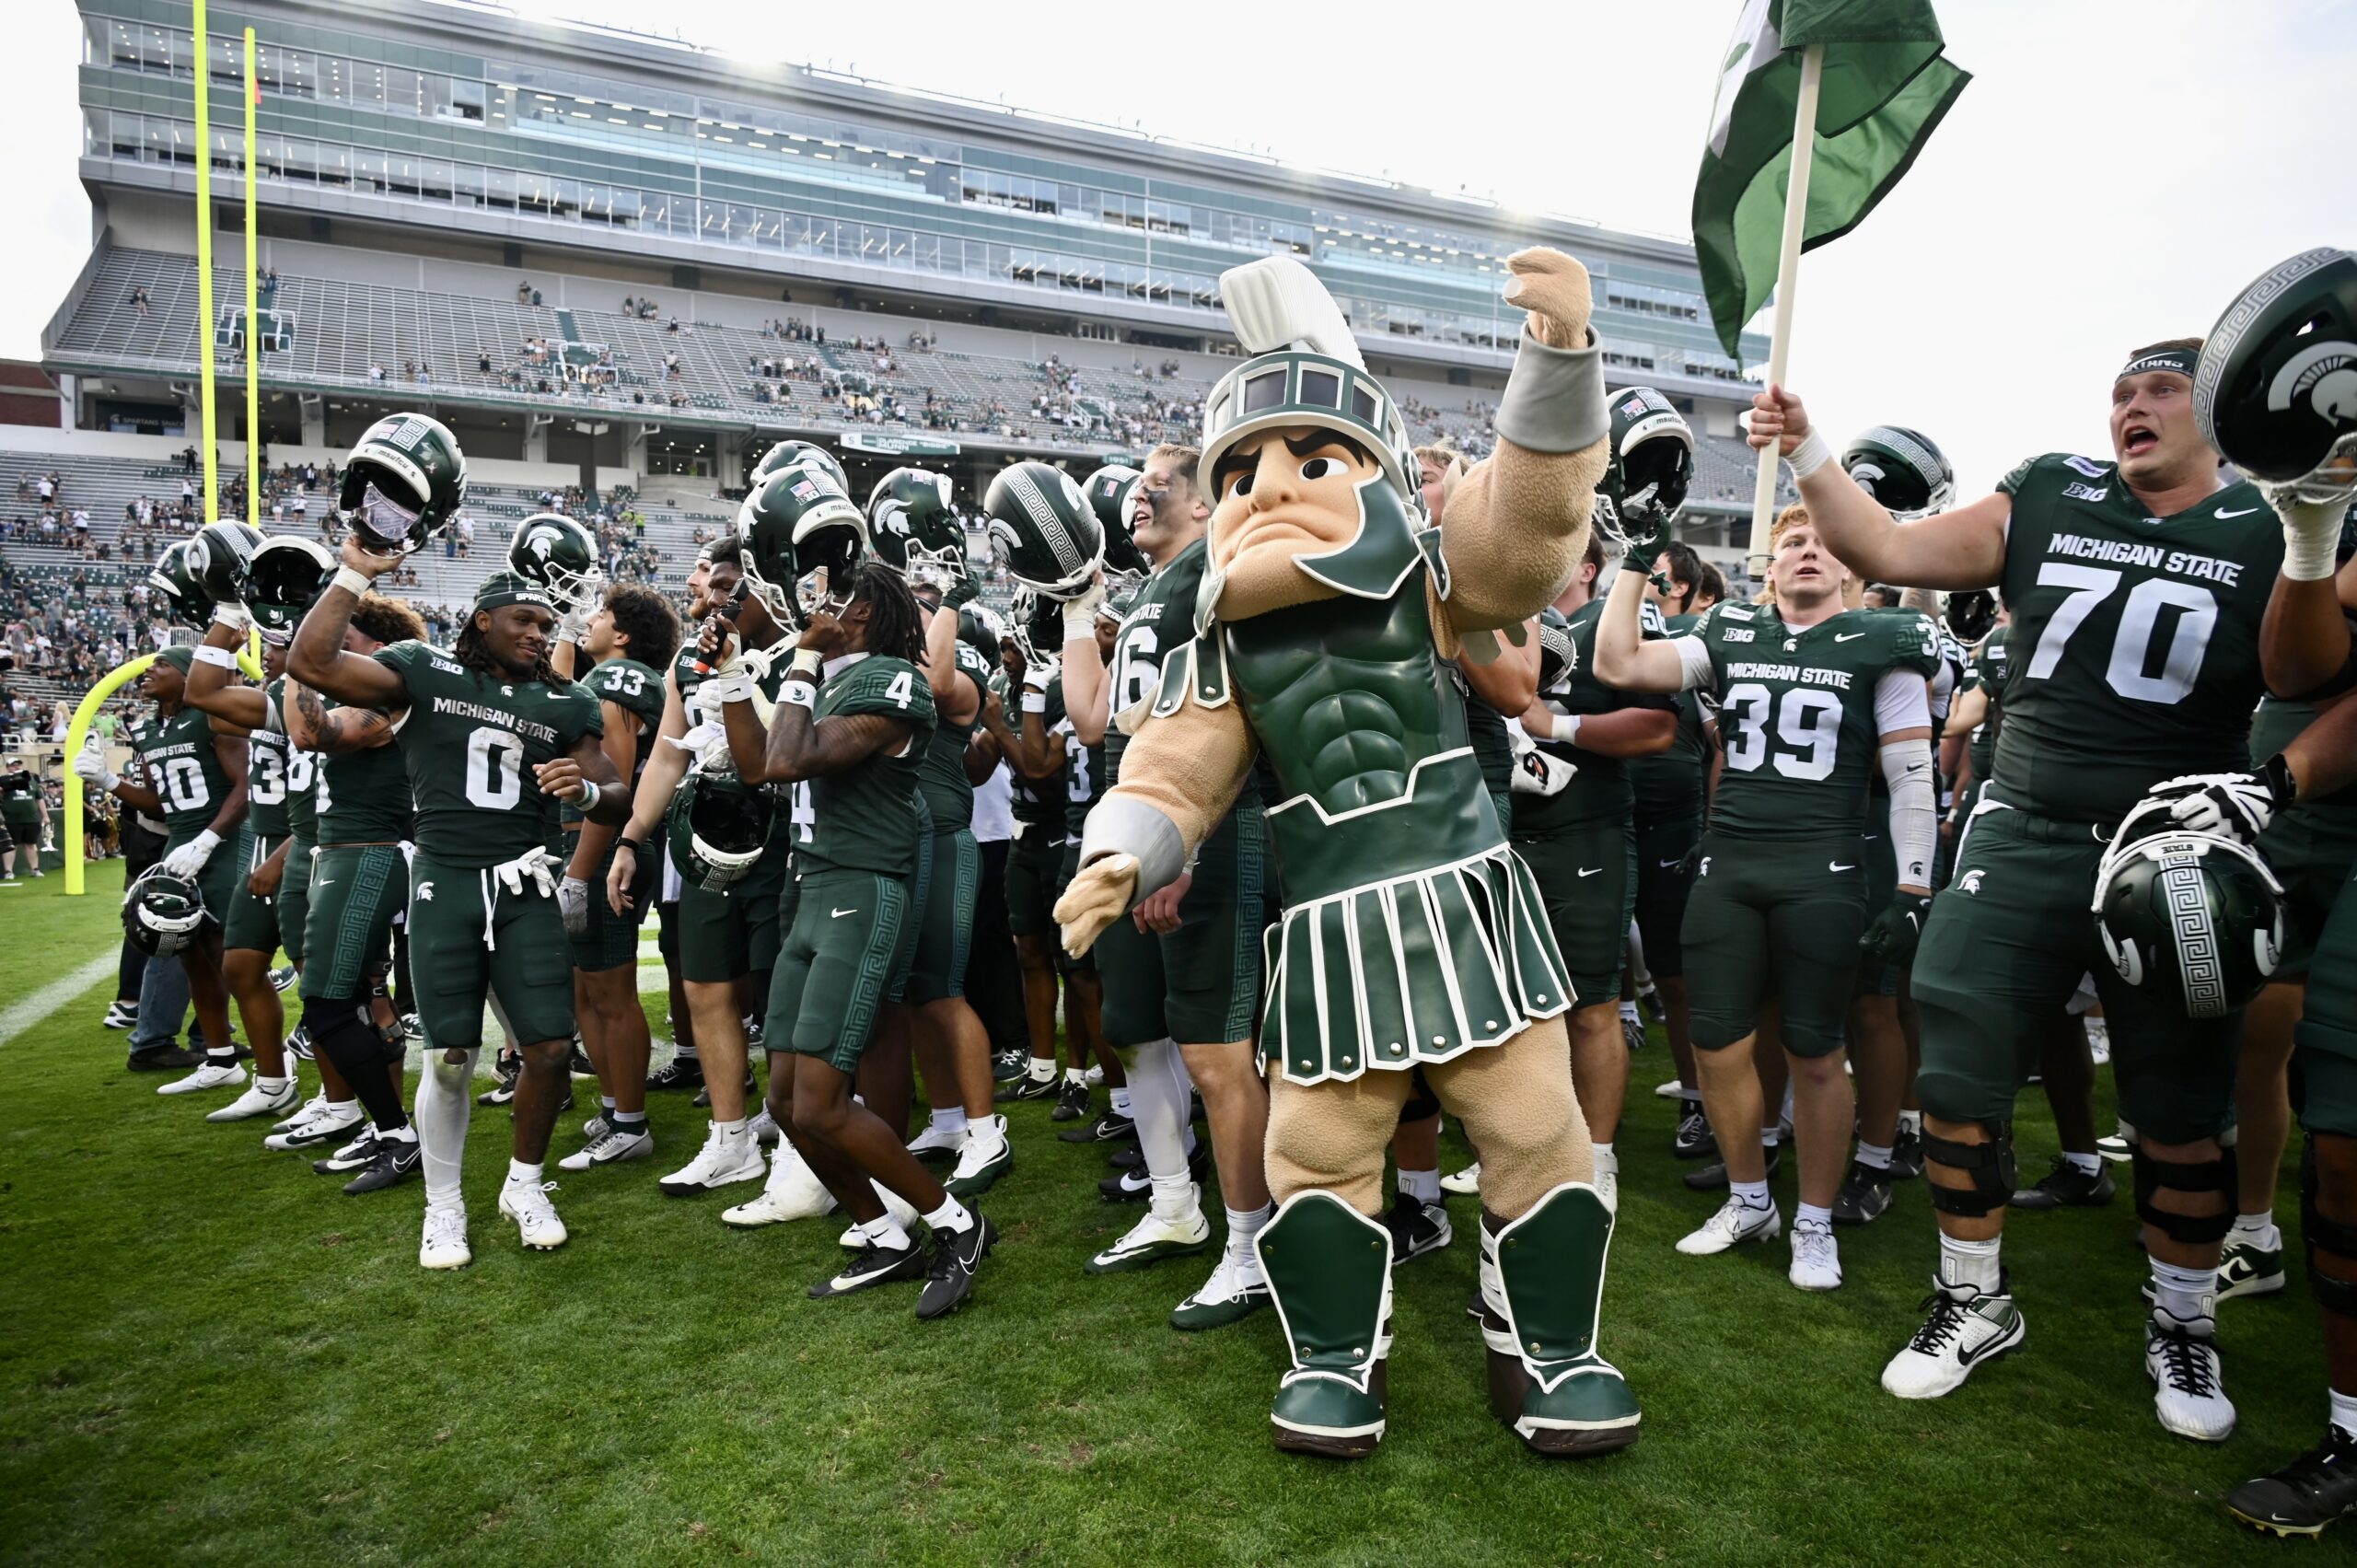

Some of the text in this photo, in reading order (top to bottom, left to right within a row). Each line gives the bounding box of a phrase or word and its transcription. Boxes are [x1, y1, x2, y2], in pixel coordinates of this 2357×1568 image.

[2061, 482, 2108, 502] BIG
[2047, 533, 2246, 588] MICHIGAN STATE
[1723, 628, 1756, 643] BIG
[2026, 563, 2219, 705] 70
[430, 656, 463, 675] BIG
[604, 666, 644, 696] 33
[1726, 662, 1853, 690] MICHIGAN STATE
[885, 671, 913, 710] 4
[433, 697, 558, 744] MICHIGAN STATE
[1723, 683, 1843, 782] 39
[168, 742, 196, 756] STATE
[466, 726, 524, 810] 0
